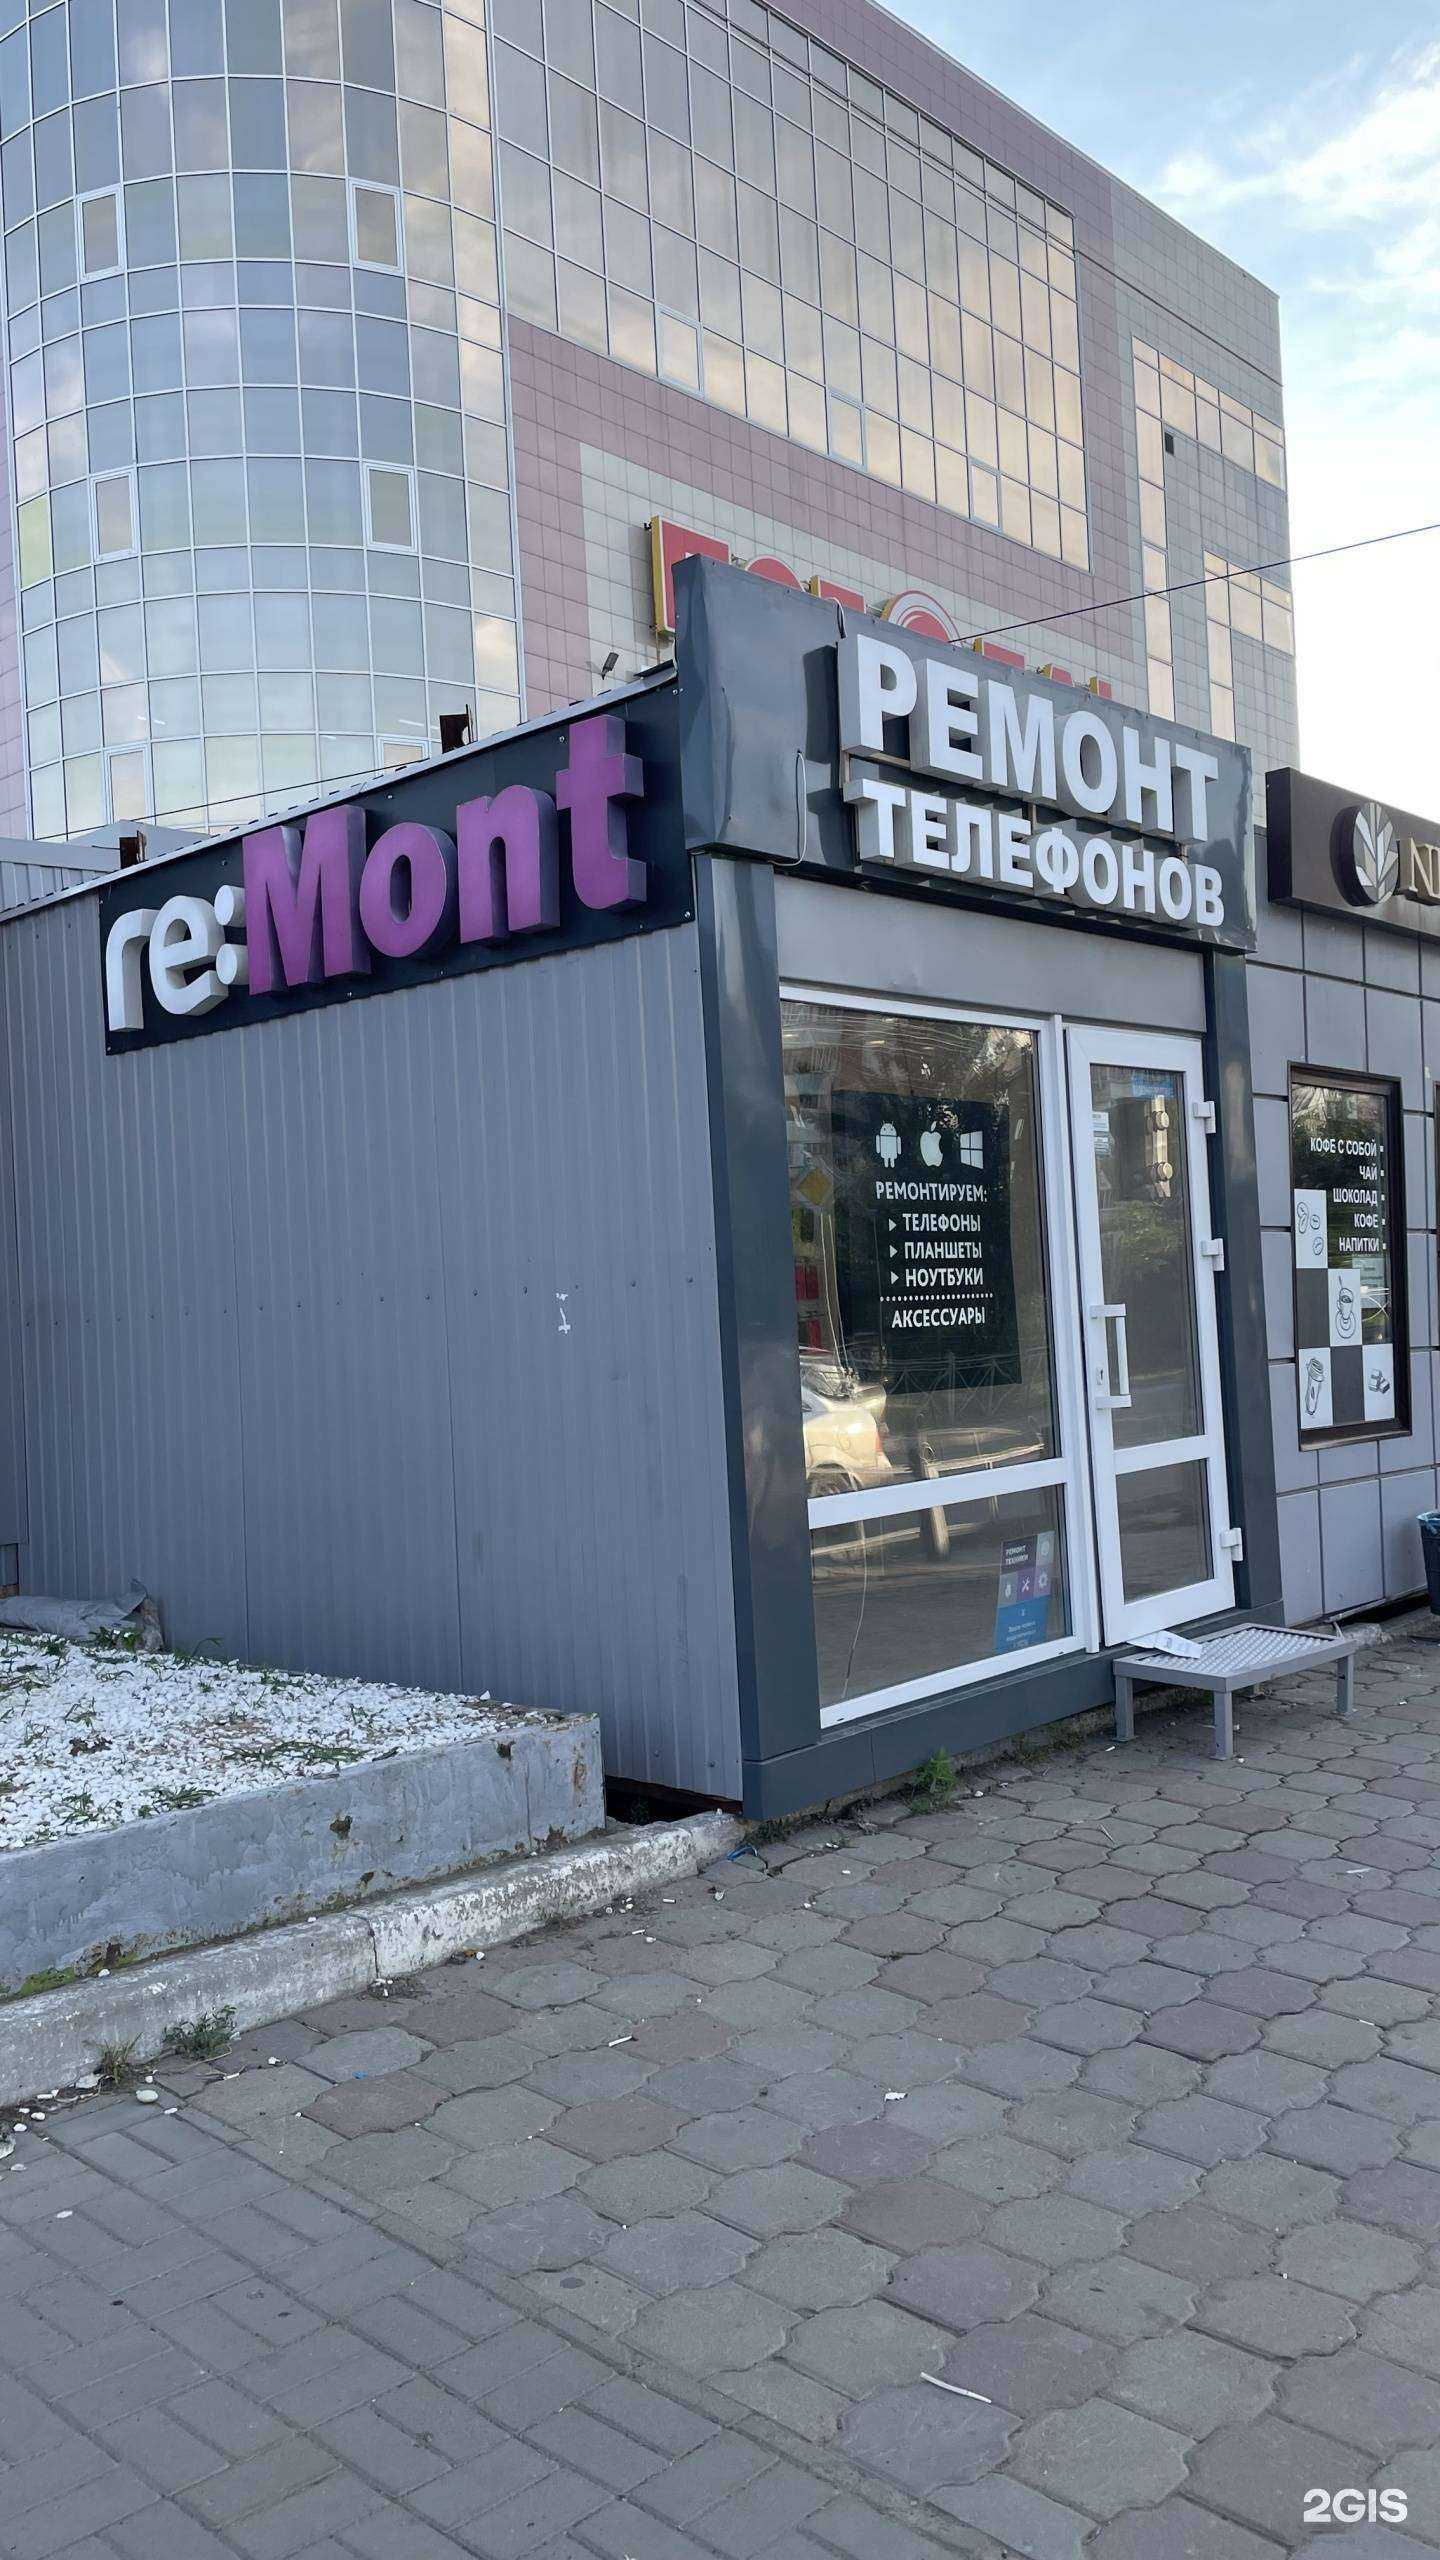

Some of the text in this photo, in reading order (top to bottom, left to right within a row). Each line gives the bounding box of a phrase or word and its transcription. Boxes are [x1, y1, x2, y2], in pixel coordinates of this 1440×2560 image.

[842, 634, 1219, 844] РЕМОНТ
[844, 778, 1225, 927] ТЕЛЕФОНОВ
[106, 714, 646, 1032] re:Mont
[1310, 1137, 1377, 1157] КОФЕ С СОБОЙ
[1359, 1163, 1378, 1180] ЧАЙ
[875, 1181, 988, 1203] РЕМОНТИРУЕМ:
[1333, 1188, 1378, 1207] ШОКОЛАД
[902, 1213, 981, 1233] ТЕЛЕФОНЫ
[1353, 1213, 1379, 1229] КОФЕ
[904, 1241, 982, 1260] ПЛАНШЕТЫ
[1338, 1237, 1380, 1252] НАПИТКИ
[905, 1268, 984, 1288] НОУТБУКИ
[891, 1306, 986, 1329] АКСЕССУАРЫ
